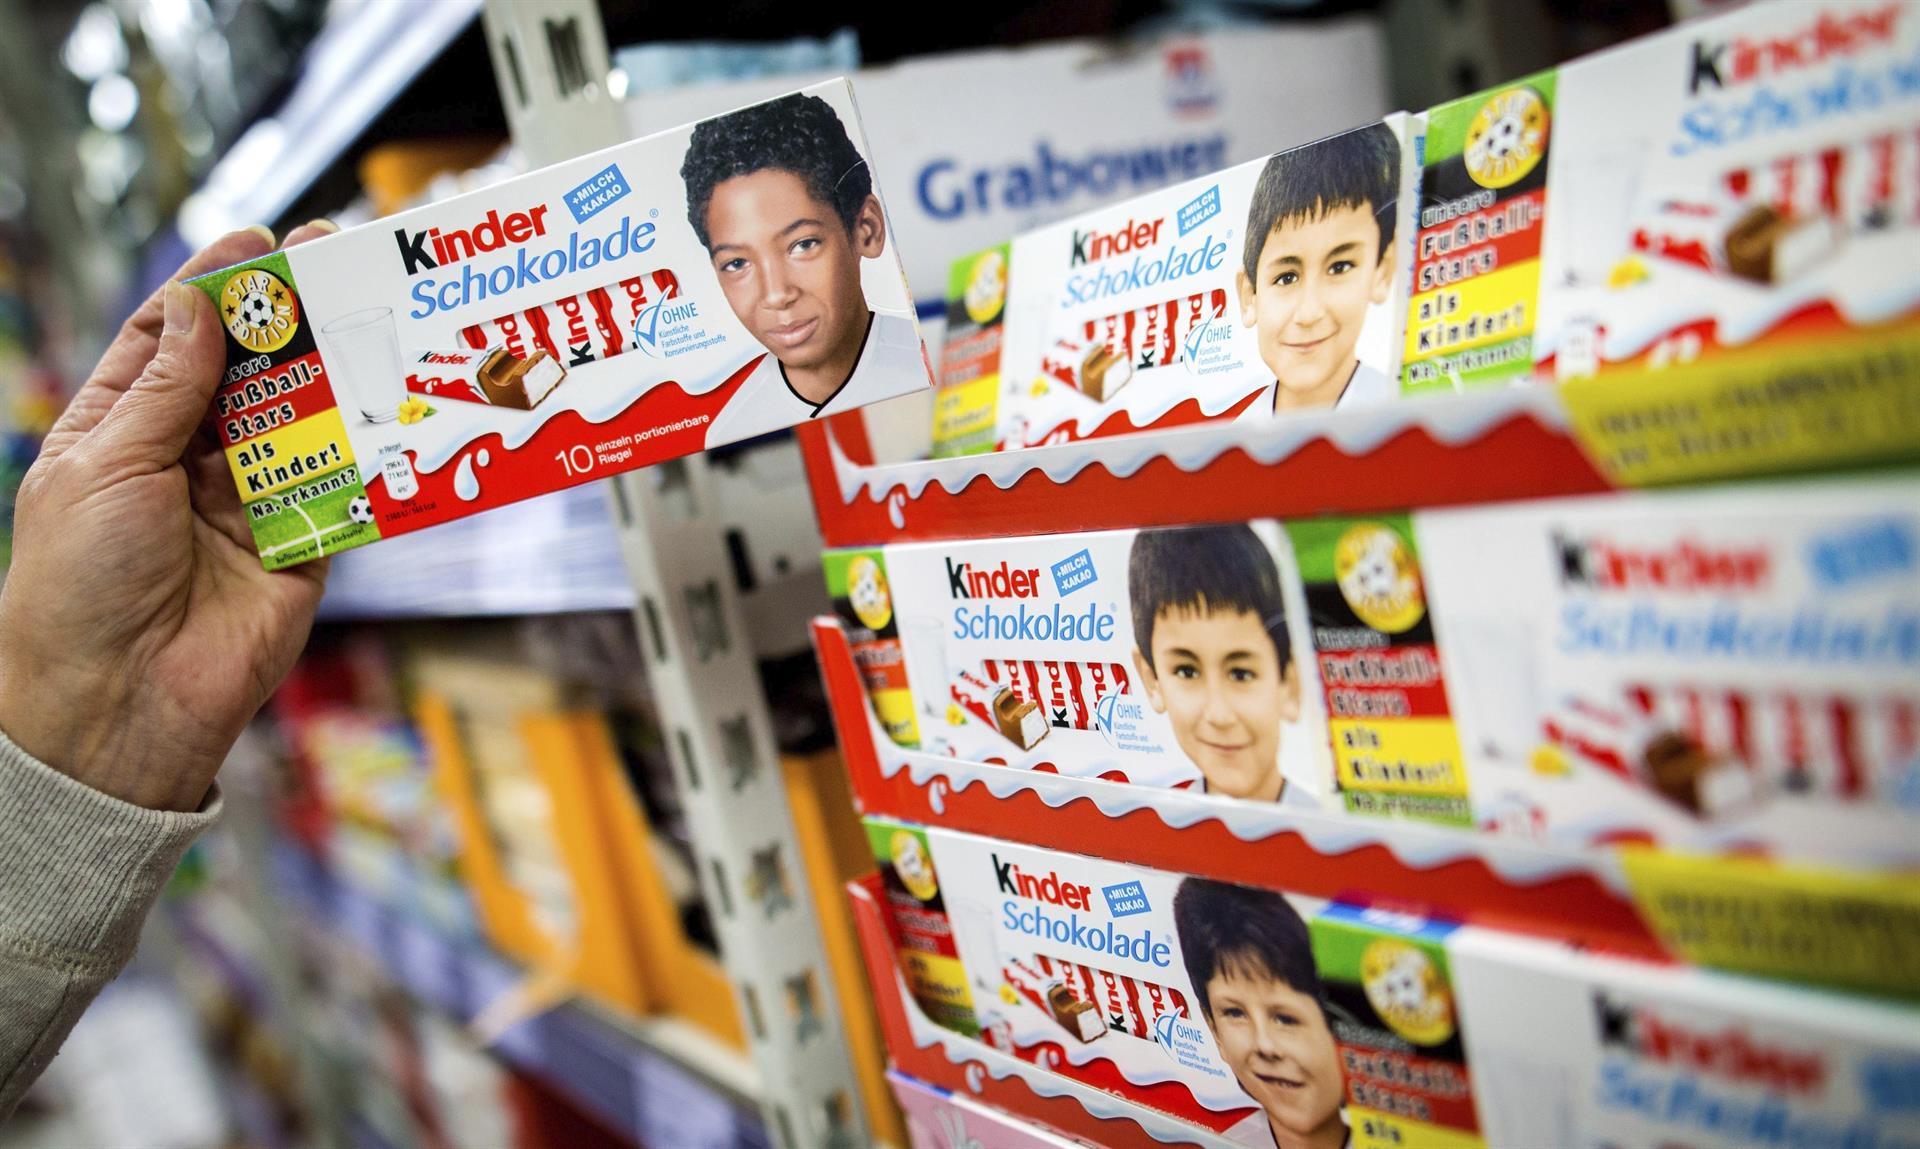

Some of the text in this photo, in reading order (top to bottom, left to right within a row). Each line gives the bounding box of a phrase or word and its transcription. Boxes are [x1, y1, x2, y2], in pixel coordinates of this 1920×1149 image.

[571, 171, 617, 205] +MILCH
[917, 134, 1228, 221] Grabower
[394, 203, 548, 276] Kinder
[1071, 217, 1165, 269] Kinder
[410, 216, 657, 320] Schokolade
[1061, 234, 1228, 309] Schokolade
[1418, 247, 1498, 292] Stars
[226, 273, 272, 306] STAR
[1419, 291, 1460, 320] als
[662, 302, 699, 325] OHNE
[1206, 325, 1232, 343] OHNE
[693, 329, 706, 341] und
[216, 361, 322, 417] Fußball-
[223, 355, 271, 386] nsere
[226, 402, 295, 443] Stars
[237, 440, 275, 467] als
[555, 414, 710, 477] 10 einzeln portionierbare
[598, 448, 632, 466] Riegel
[245, 442, 341, 493] Kinder!
[252, 467, 358, 520] Na, erkannt?
[945, 556, 1040, 599] Kinder
[953, 602, 1115, 642] Schokolade
[1117, 703, 1143, 720] OHNE
[992, 853, 1092, 913] Kinder
[1108, 885, 1140, 902] +MILCH
[1003, 900, 1171, 968] Schokolade
[1176, 1024, 1204, 1044] OHNE
